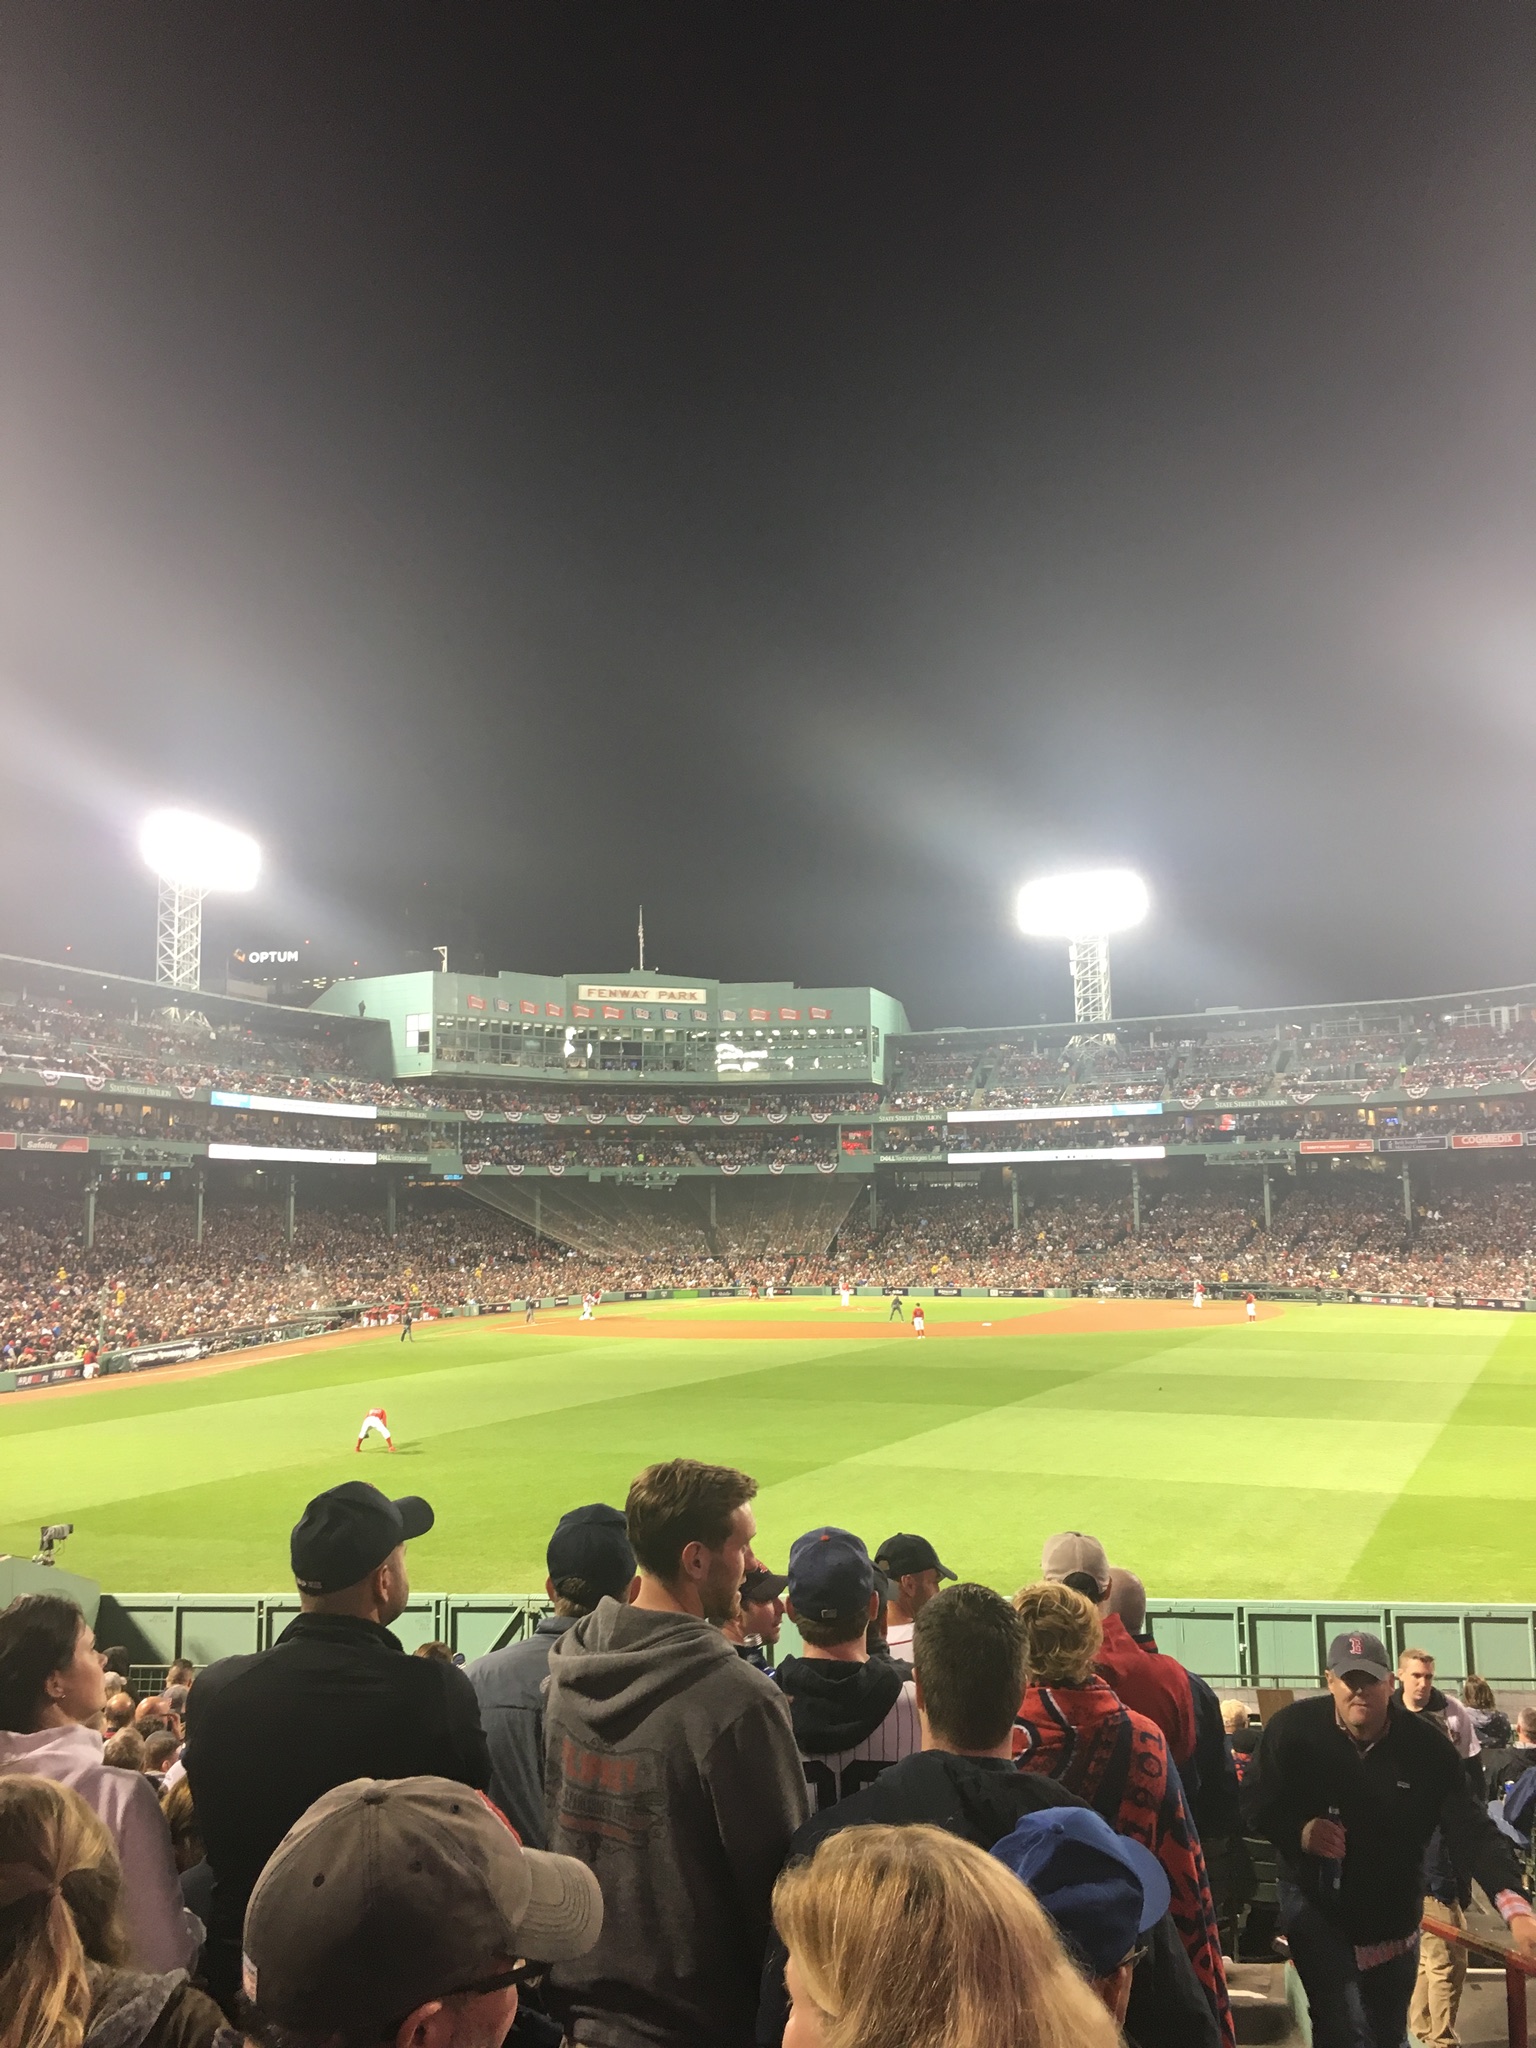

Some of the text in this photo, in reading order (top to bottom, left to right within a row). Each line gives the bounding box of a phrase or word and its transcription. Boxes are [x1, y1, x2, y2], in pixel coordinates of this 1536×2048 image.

[248, 950, 299, 963] OPTUM
[587, 988, 698, 1001] FENWAY PARK
[1215, 1099, 1288, 1109] STATE STREET PAVILION
[895, 1114, 915, 1122] STREET
[1461, 1134, 1514, 1145] COGMEDIX
[880, 1154, 895, 1162] DELL
[1349, 1637, 1364, 1655] B
